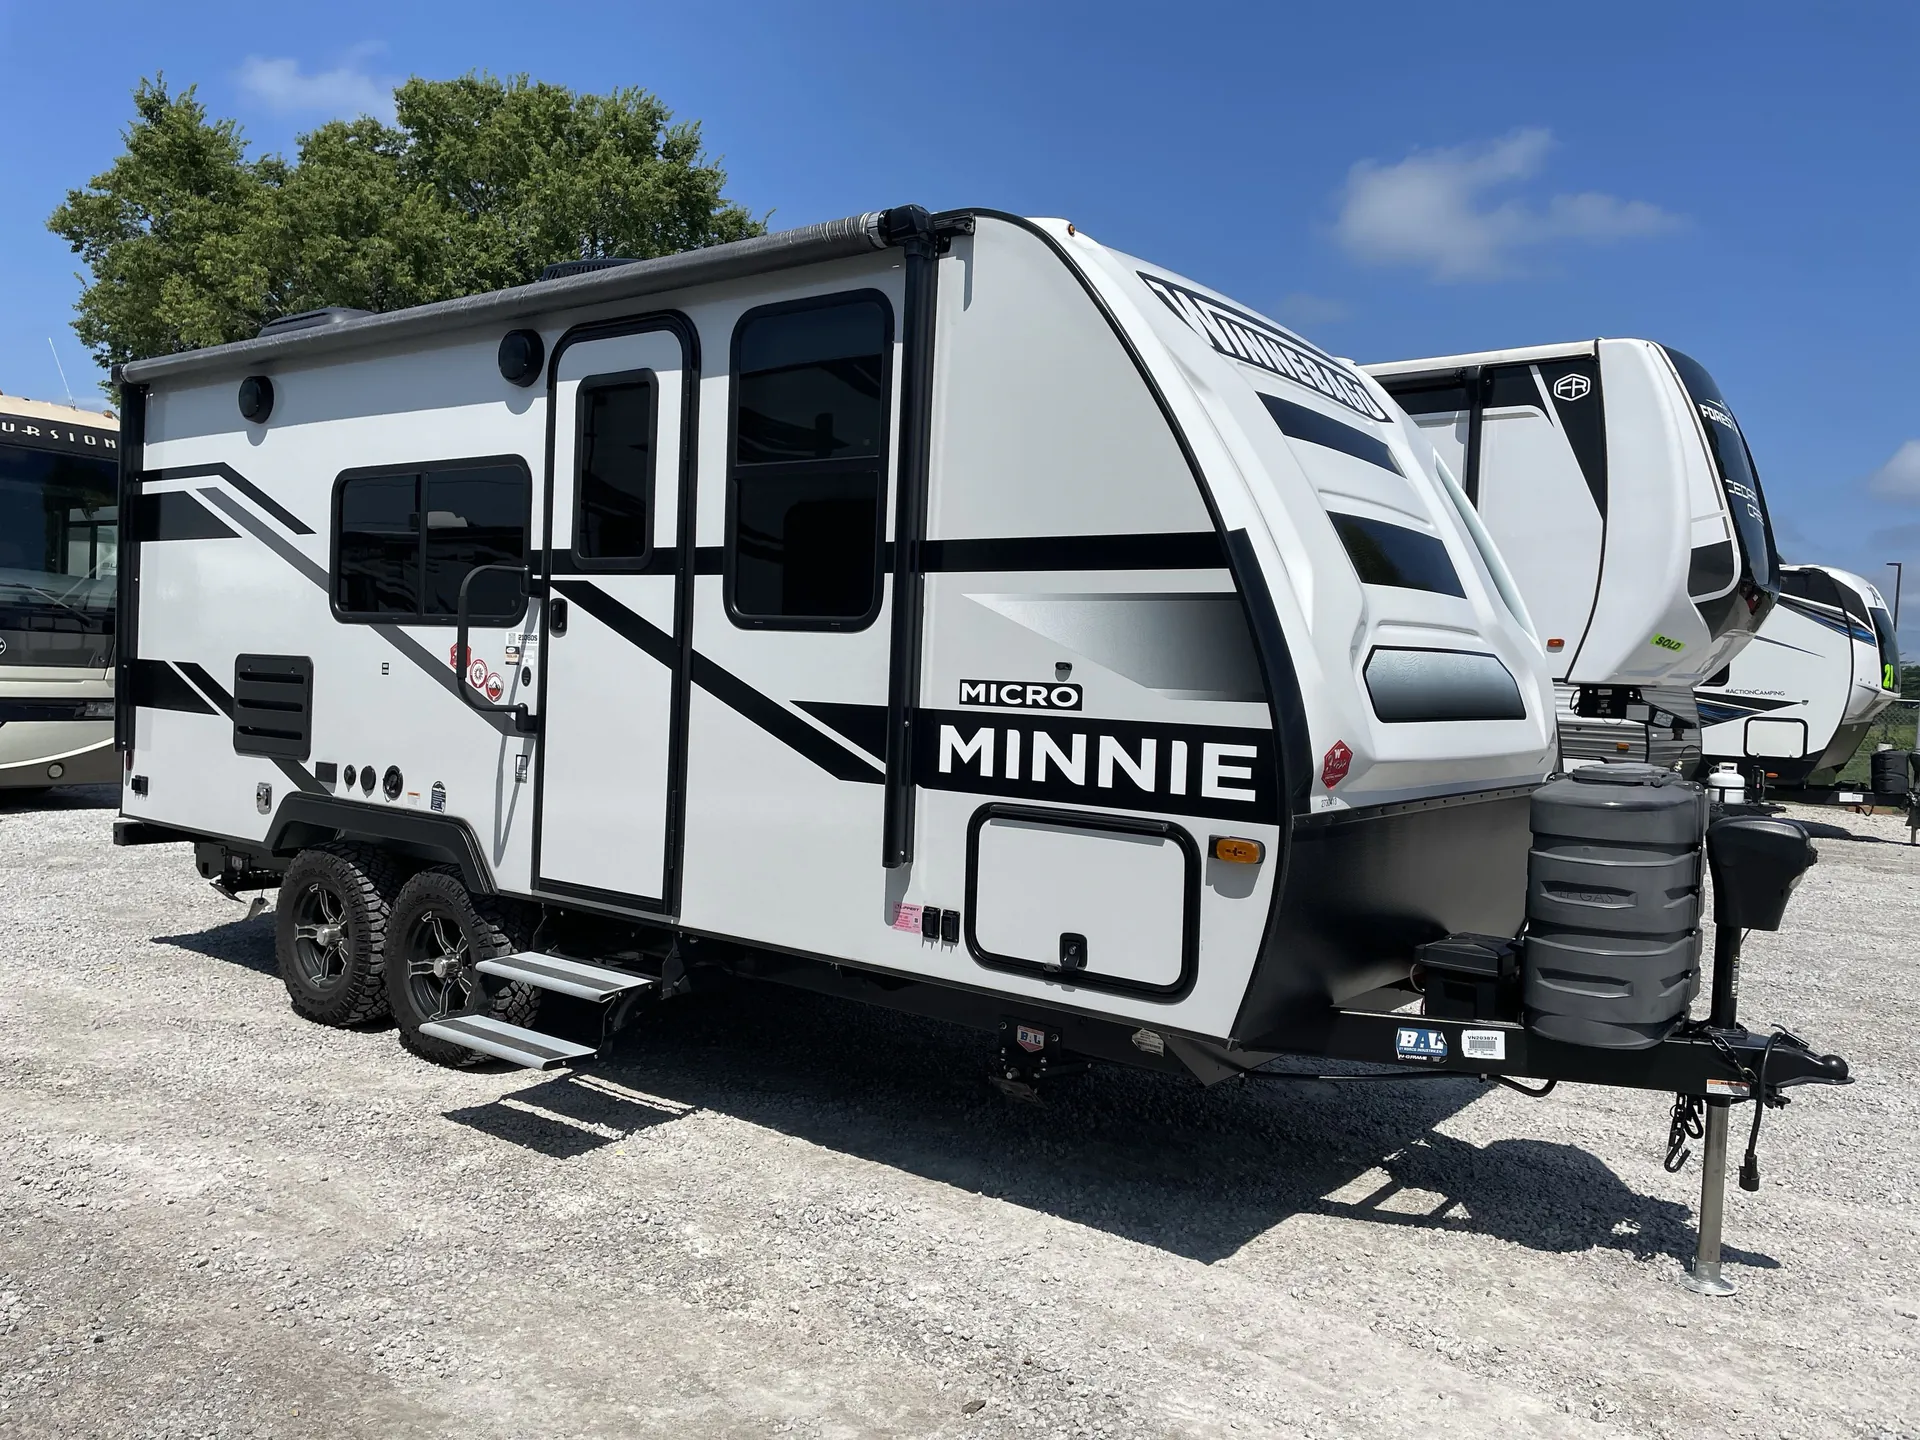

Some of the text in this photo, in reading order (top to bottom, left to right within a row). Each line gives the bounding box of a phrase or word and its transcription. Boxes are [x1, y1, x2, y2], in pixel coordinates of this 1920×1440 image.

[1144, 278, 1386, 420] WINNEBAGO
[1655, 636, 1682, 651] SOLD
[961, 681, 1079, 708] MICRO
[938, 724, 1258, 803] MINNIE
[1579, 892, 1613, 904] GAS
